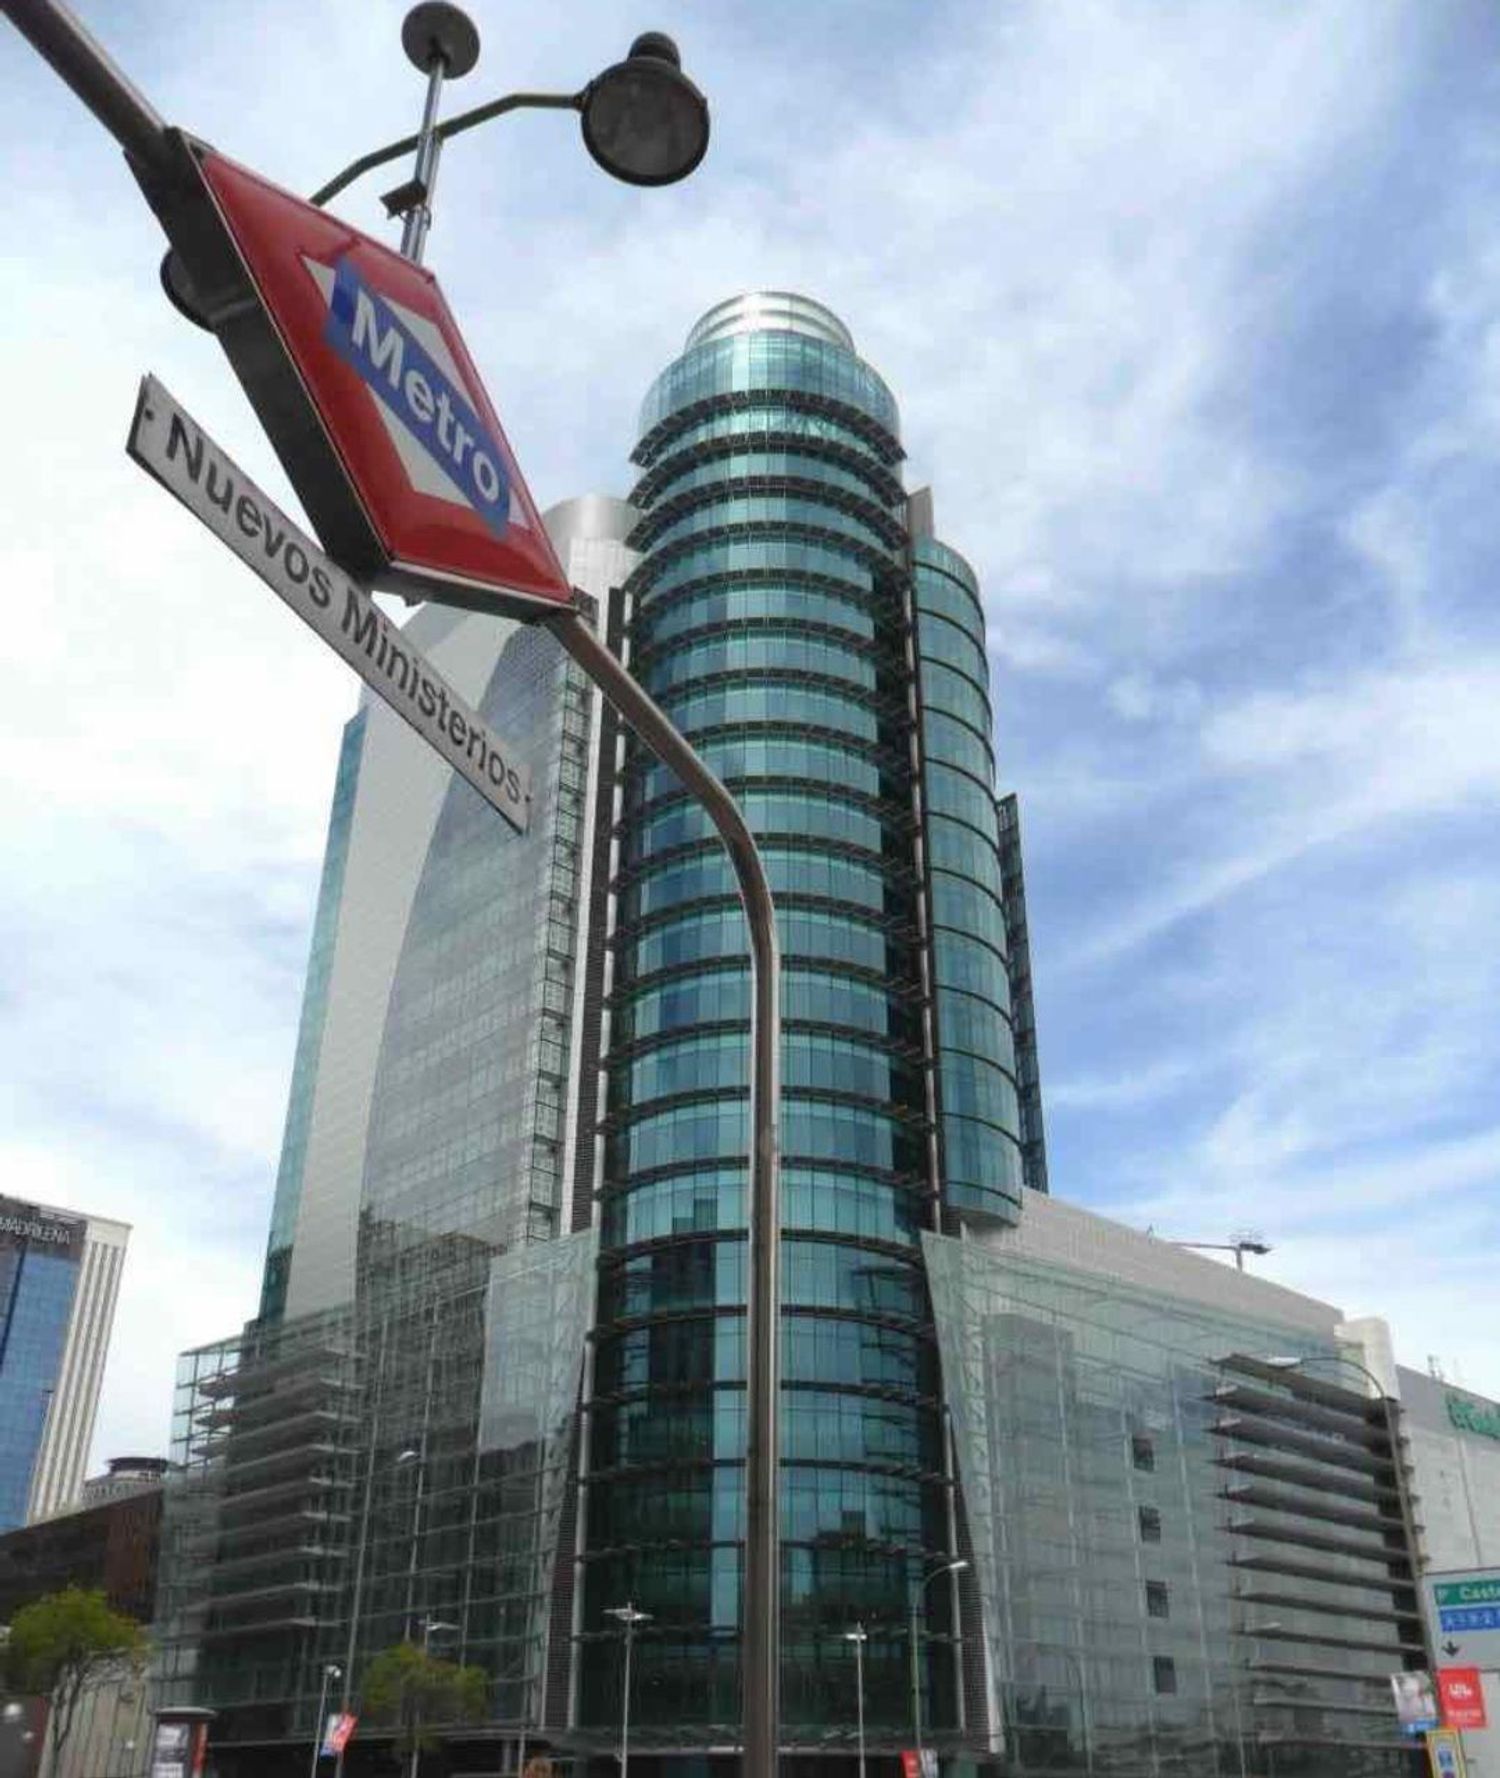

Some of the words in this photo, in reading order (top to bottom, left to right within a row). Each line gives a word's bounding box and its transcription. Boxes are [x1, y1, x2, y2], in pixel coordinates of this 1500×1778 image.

[352, 286, 499, 504] Metro
[166, 412, 332, 608] Nuevos
[341, 585, 520, 803] Ministerios
